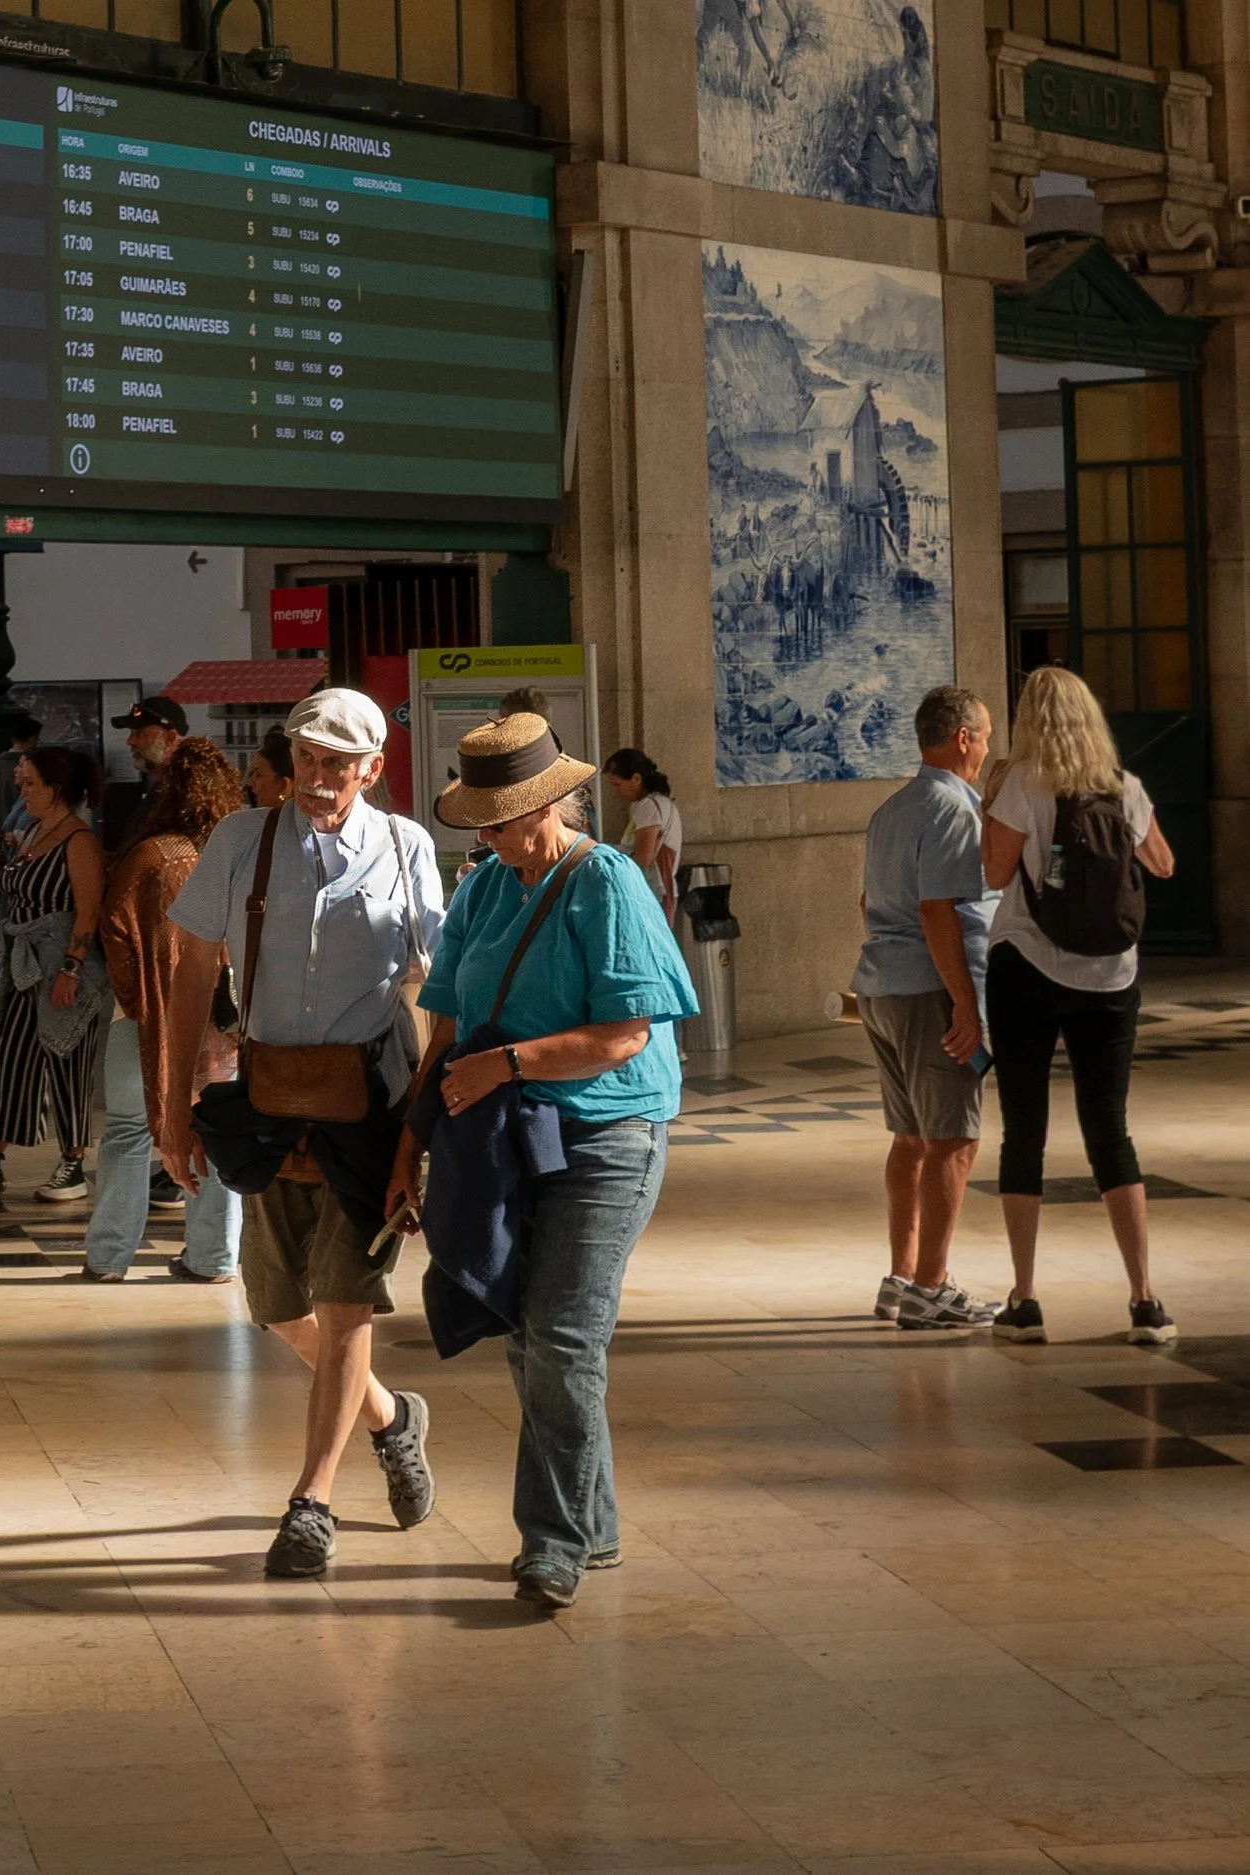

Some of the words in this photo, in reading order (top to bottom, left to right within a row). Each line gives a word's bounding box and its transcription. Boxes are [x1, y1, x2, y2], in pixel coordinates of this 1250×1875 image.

[74, 92, 117, 107] Infraestruturas
[84, 104, 106, 117] Portugal
[249, 121, 320, 146] CHEGADAS
[324, 133, 327, 148] /
[330, 134, 390, 157] ARRIVALS
[62, 136, 84, 147] HORA
[118, 144, 148, 156] ORIGEM
[245, 162, 254, 171] LN
[271, 165, 304, 178] COMBOIO
[353, 177, 401, 192] OBSERVAÇÕES
[63, 164, 91, 180] 16:35
[119, 171, 159, 189] AVEIRO
[247, 188, 253, 201] 6
[272, 193, 290, 204] SUBU
[63, 199, 92, 215] 16:45
[119, 206, 159, 224] BRAGA
[248, 222, 254, 235] 5
[273, 226, 291, 237] SUBU
[299, 230, 318, 240] 15234
[64, 235, 92, 251] 17:00
[120, 241, 173, 260] PENAFIEL
[249, 256, 254, 268] 3
[273, 260, 292, 271] SUBU
[300, 263, 319, 274] 15420
[64, 271, 93, 286] 17:05
[121, 276, 186, 296] GUIMARÃES
[249, 290, 255, 302] 4
[274, 294, 293, 304] SUBU
[65, 306, 93, 321] 17:30
[121, 311, 162, 328] MARCO
[165, 316, 229, 334] CANAVESES
[250, 324, 255, 336] 4
[275, 327, 293, 338] SUBU
[66, 342, 94, 357] 17:35
[122, 347, 162, 363] AVEIRO
[251, 357, 255, 370] 1
[275, 360, 294, 371] SUBU
[66, 378, 94, 392] 17:45
[123, 382, 162, 397] BRAGA
[251, 391, 257, 404] 3
[276, 394, 294, 404] SUBU
[67, 413, 95, 428] 18:00
[123, 417, 176, 433] PENAFIEL
[252, 425, 256, 438] 1
[277, 428, 295, 438] SUBU
[303, 430, 323, 440] 15422
[274, 608, 322, 622] memory
[524, 657, 562, 665] PORTUGAL
